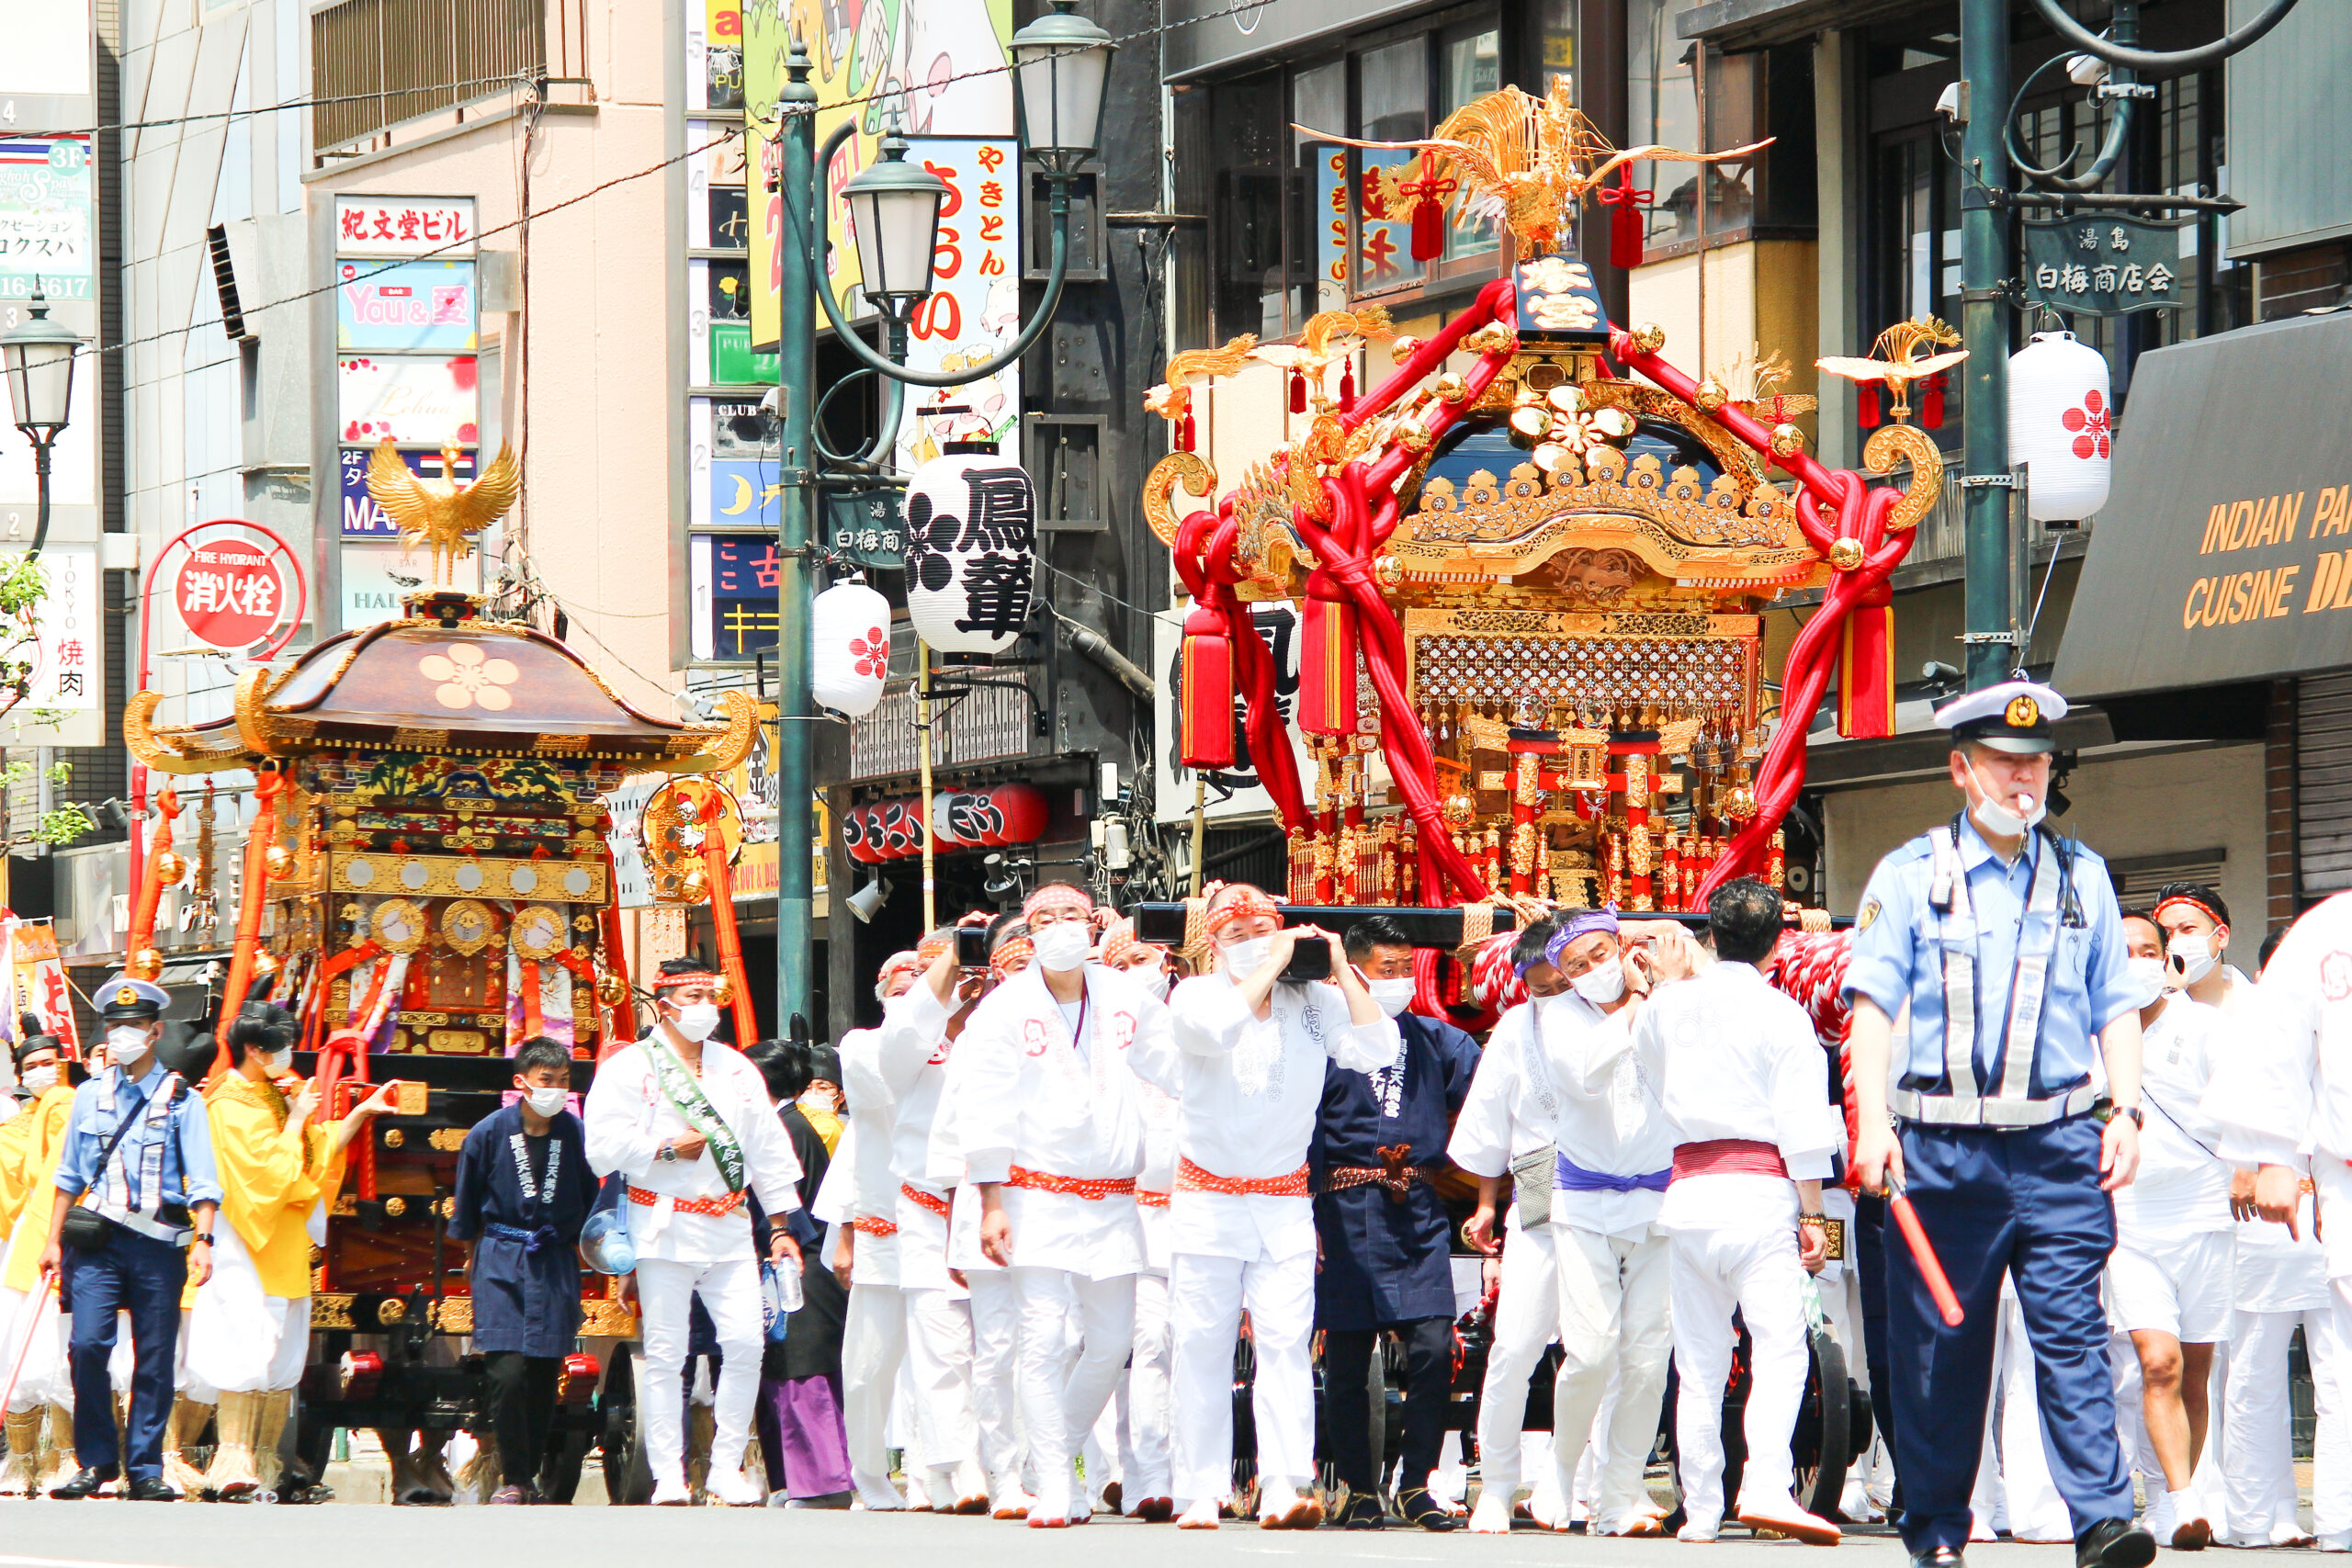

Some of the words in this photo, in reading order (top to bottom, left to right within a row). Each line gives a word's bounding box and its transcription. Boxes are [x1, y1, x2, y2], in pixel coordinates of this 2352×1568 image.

[3, 100, 16, 125] 4
[52, 147, 82, 168] 3F
[342, 208, 468, 241] 紀文堂ビル
[978, 146, 1006, 276] やきとん
[2078, 226, 2131, 251] 湯島
[2035, 263, 2175, 294] 白梅商店会
[344, 283, 405, 325] You
[408, 299, 430, 325] &
[432, 285, 469, 325] 愛
[6, 307, 17, 330] 3
[691, 310, 707, 338] 3
[718, 404, 760, 416] CLUB
[342, 451, 363, 465] 2F
[695, 444, 707, 471] 2
[9, 513, 20, 536] 2
[345, 496, 397, 530] MA
[2199, 491, 2305, 556] INDIAN
[836, 527, 906, 552] 白梅商
[195, 551, 217, 564] FIRE
[220, 552, 268, 566] HYDRANT
[65, 555, 76, 630] TOKYO
[185, 570, 277, 616] 消火栓
[2183, 564, 2301, 630] CUISINE
[58, 637, 84, 696] 焼肉
